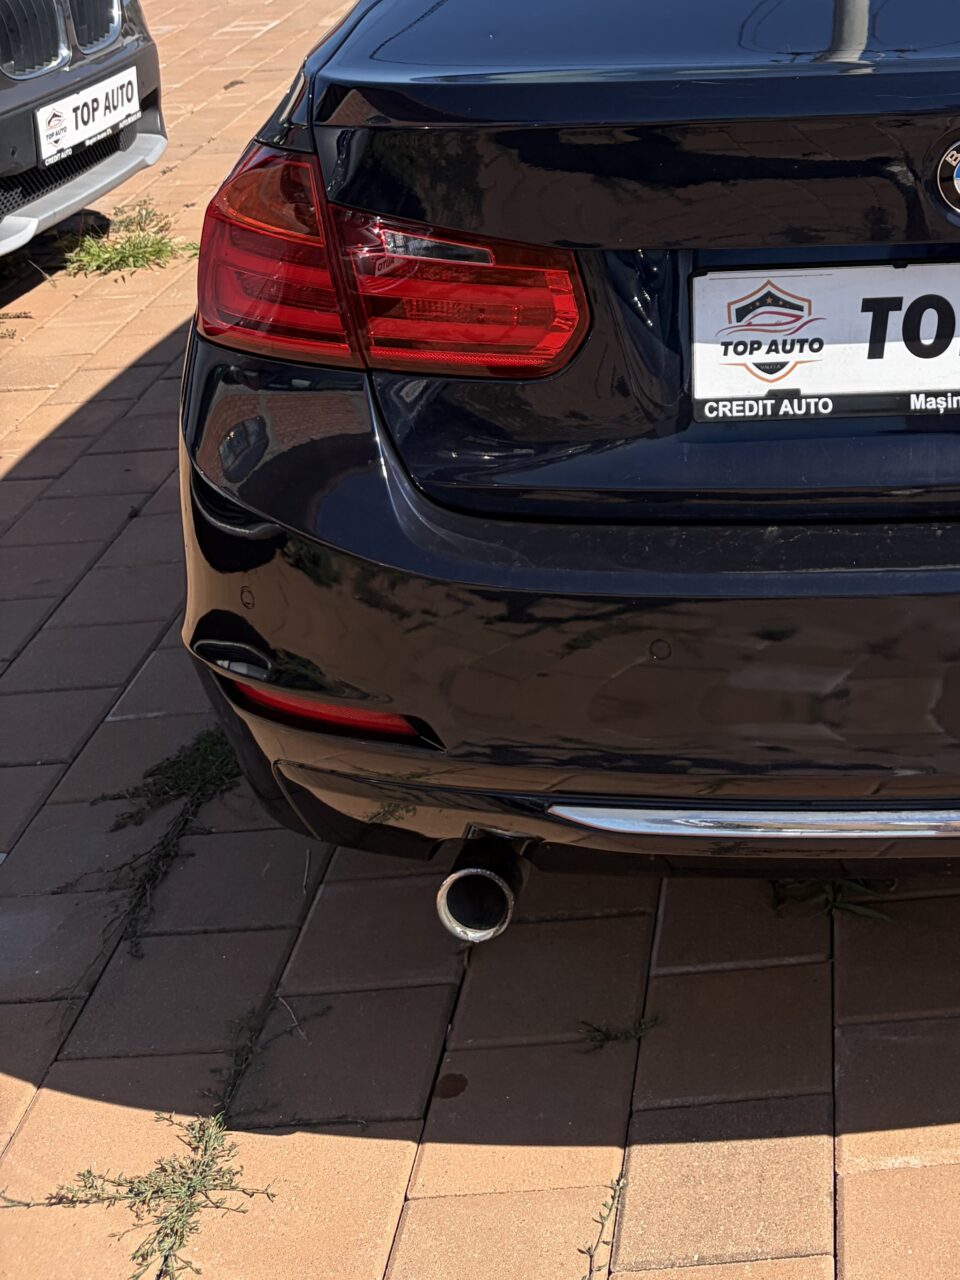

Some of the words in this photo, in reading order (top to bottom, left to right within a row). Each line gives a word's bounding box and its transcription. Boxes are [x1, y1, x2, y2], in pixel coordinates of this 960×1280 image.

[72, 97, 100, 131] TOP
[103, 80, 134, 117] AUTO
[45, 132, 55, 141] TOP
[55, 126, 67, 137] AUTO
[720, 340, 763, 356] TOP
[765, 337, 824, 355] AUTO
[704, 399, 776, 418] CREDIT
[779, 398, 833, 415] AUTO
